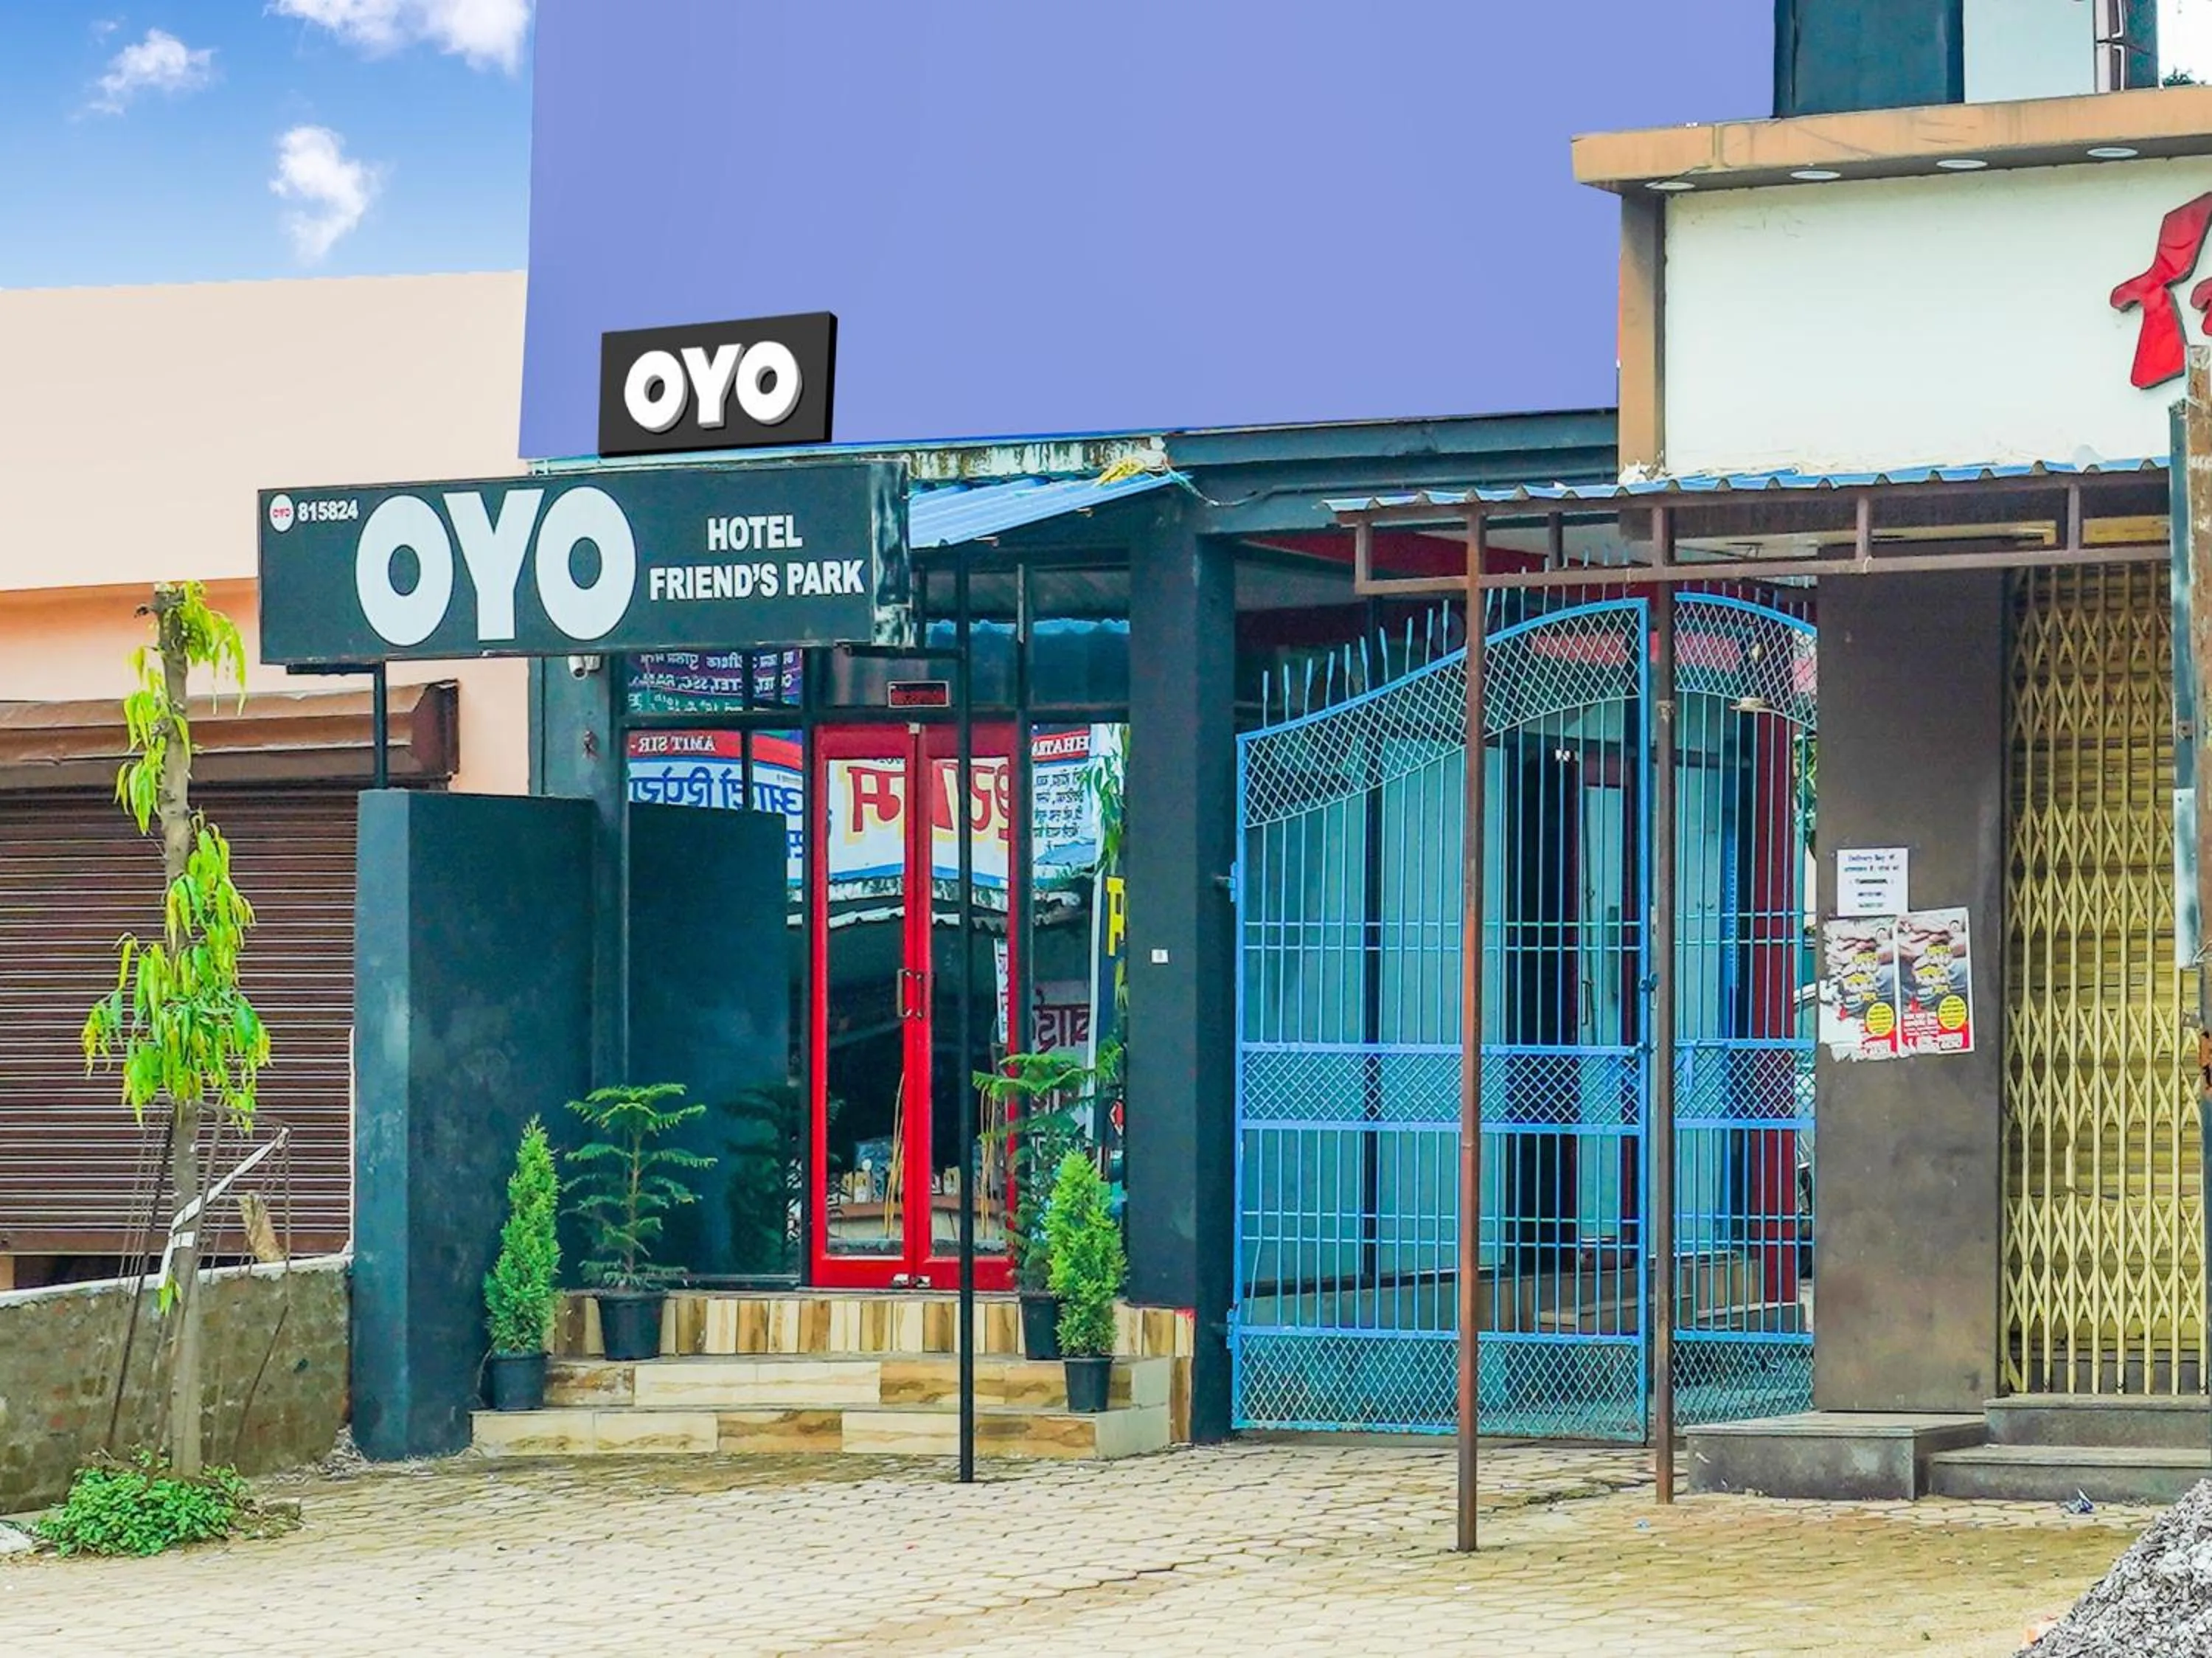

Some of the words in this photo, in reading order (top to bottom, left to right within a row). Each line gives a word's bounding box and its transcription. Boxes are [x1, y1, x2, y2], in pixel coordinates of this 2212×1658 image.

[624, 340, 803, 431] OYO
[297, 499, 359, 521] 815824
[707, 514, 803, 551] HOTEL
[355, 486, 636, 646] OYO
[649, 562, 779, 601] FRIEND'S
[786, 559, 865, 596] PARK
